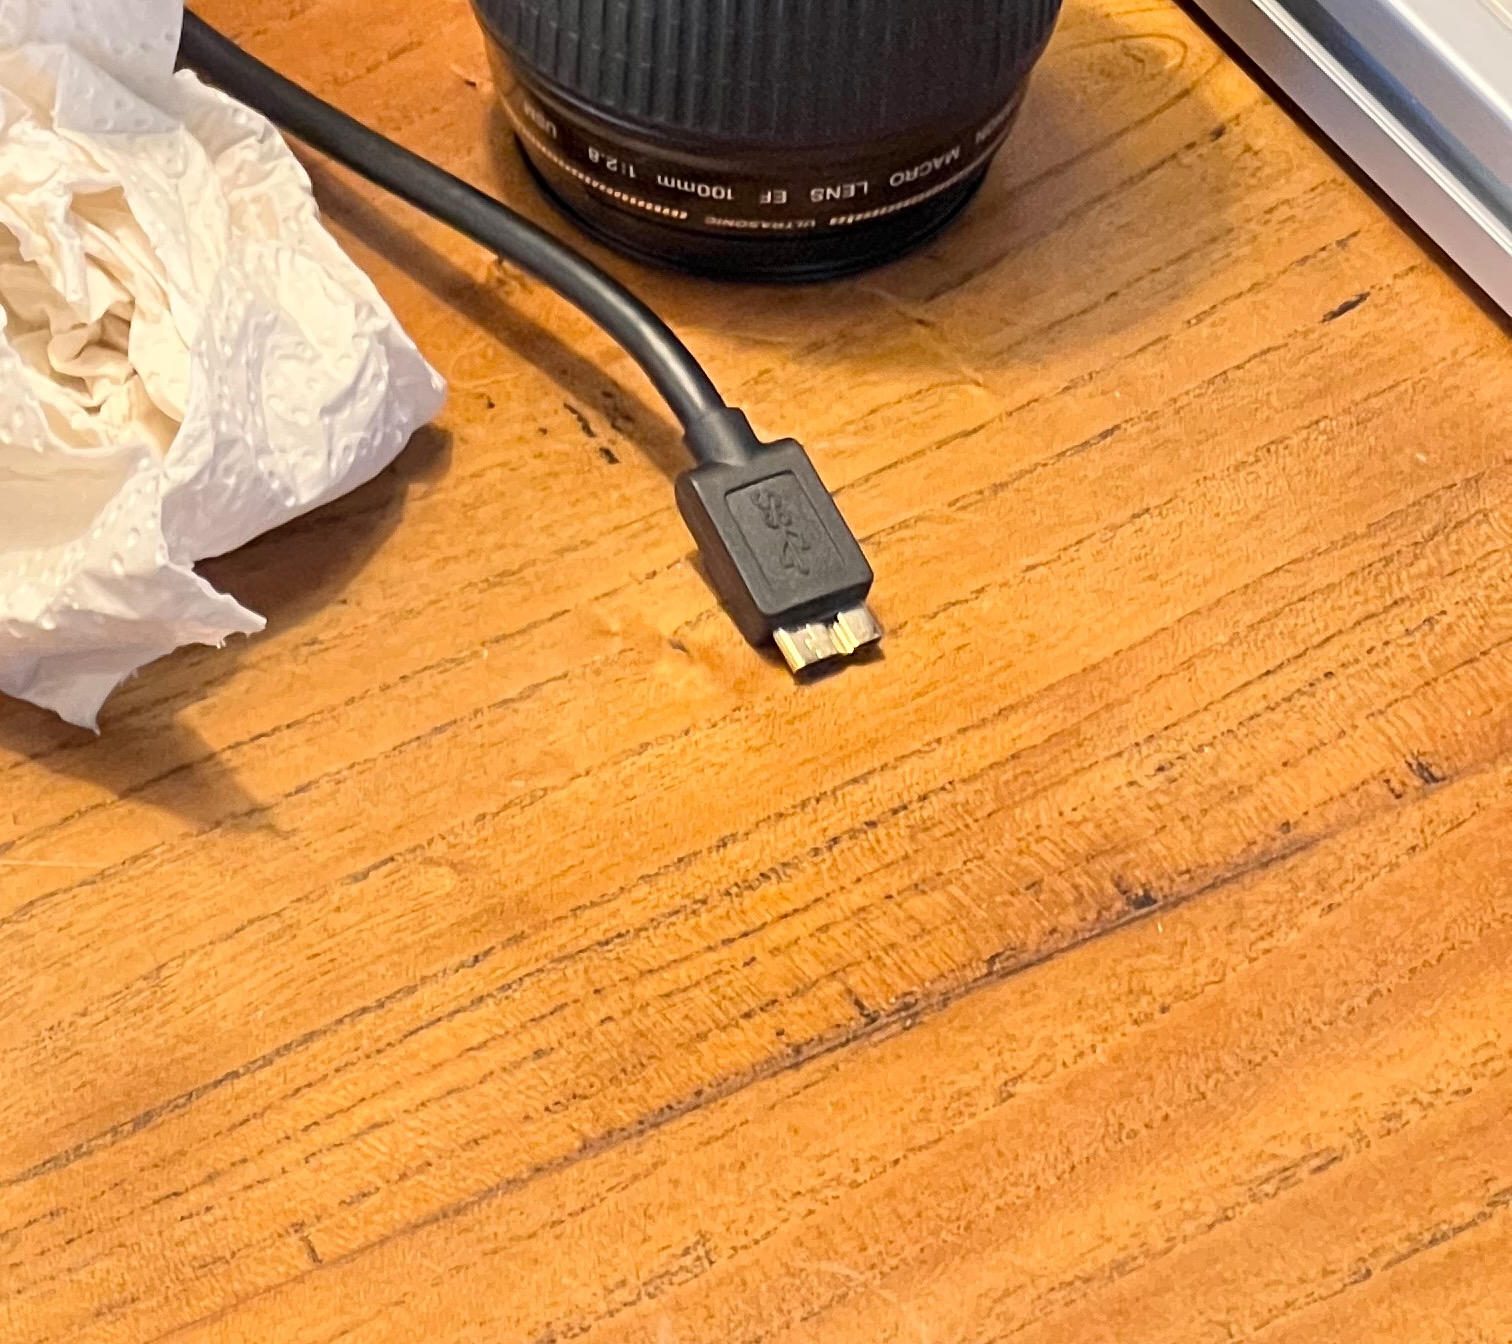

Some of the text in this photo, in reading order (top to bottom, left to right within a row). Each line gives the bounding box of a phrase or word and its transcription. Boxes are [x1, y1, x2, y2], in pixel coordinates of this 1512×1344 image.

[889, 143, 961, 188] MACRO
[656, 173, 736, 202] 100mm
[759, 187, 787, 205] EF
[810, 178, 869, 202] LENS
